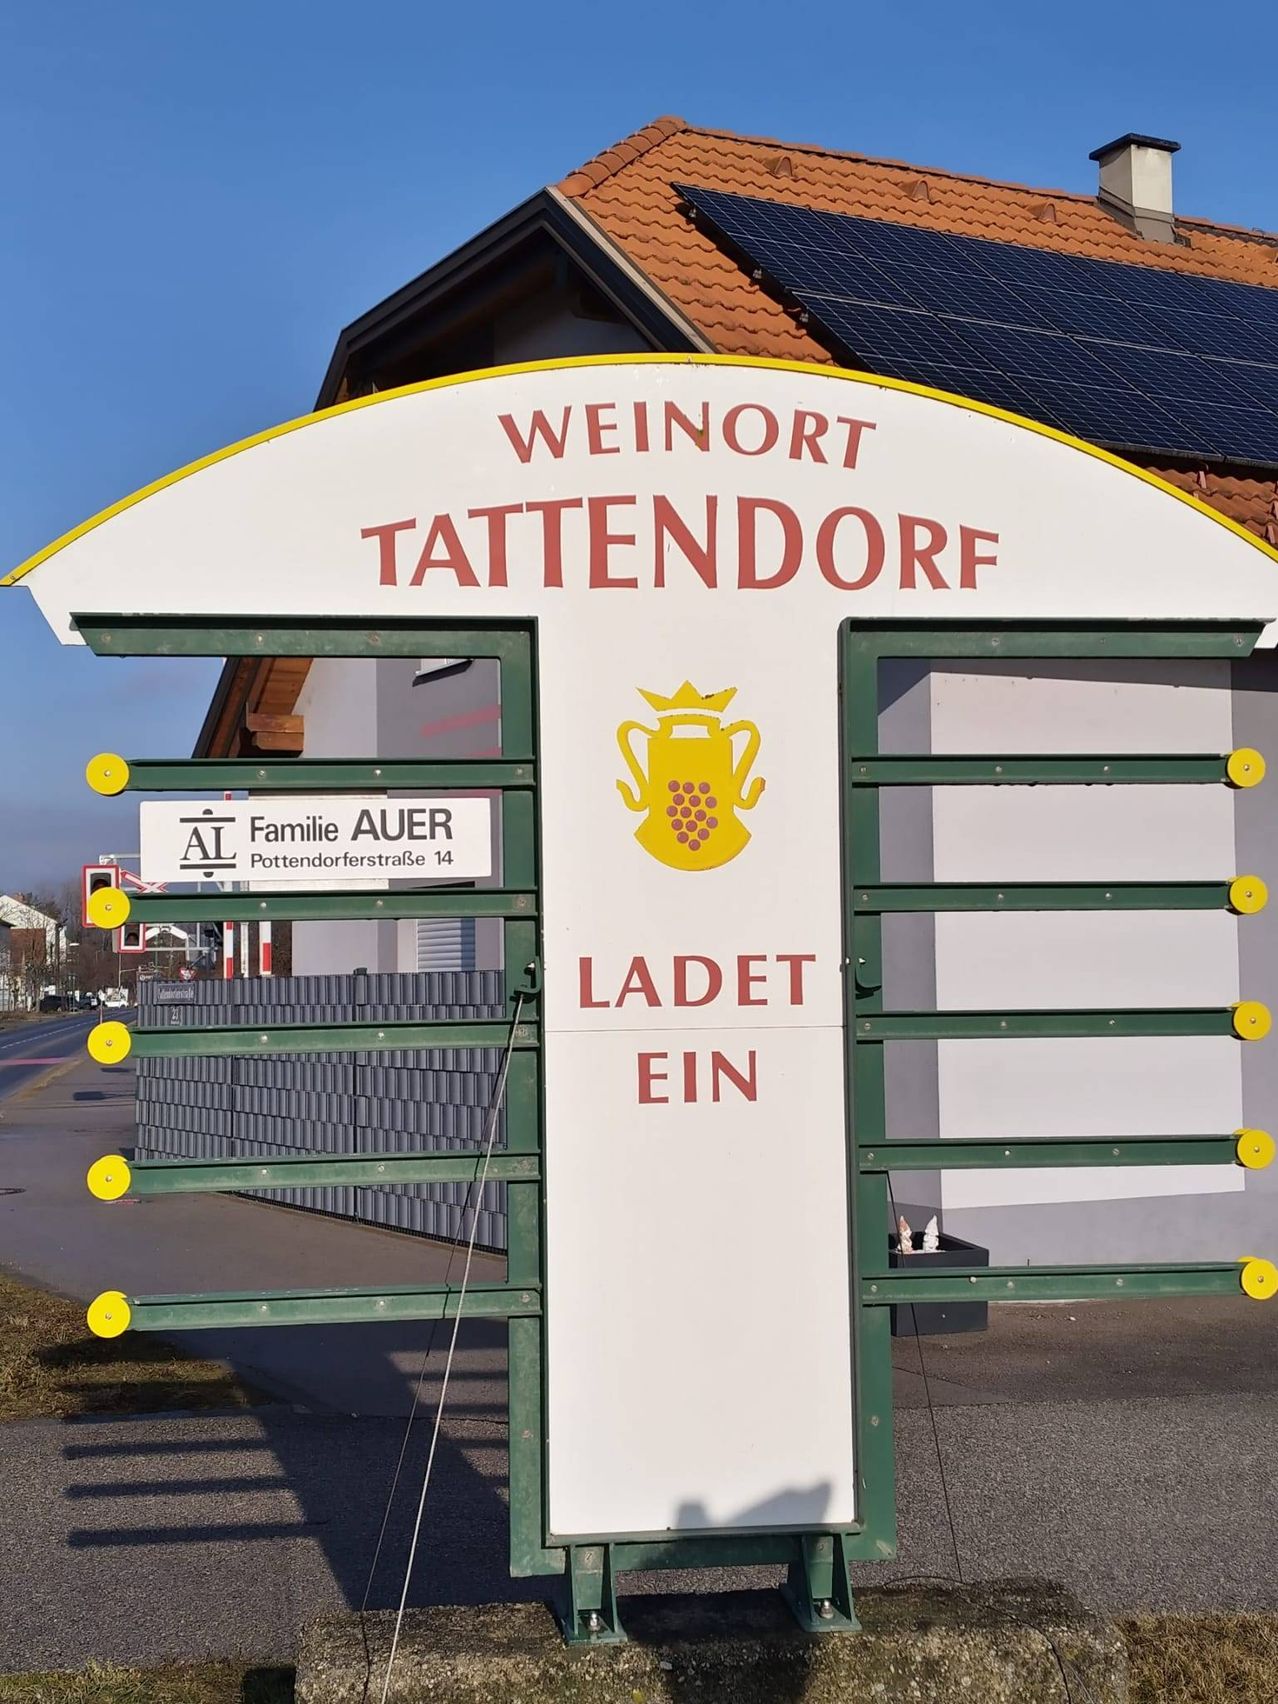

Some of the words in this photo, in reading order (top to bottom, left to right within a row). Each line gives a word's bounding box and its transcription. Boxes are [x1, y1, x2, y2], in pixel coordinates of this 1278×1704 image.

[499, 401, 877, 470] WEINORT
[361, 494, 999, 591] TATTENDORF
[180, 826, 237, 861] AL
[250, 815, 339, 843] Familie
[350, 808, 453, 842] AUER
[250, 850, 426, 869] Pottendorferstraße
[433, 850, 454, 866] 14
[579, 954, 816, 1009] LADET
[637, 1050, 757, 1104] EIN
